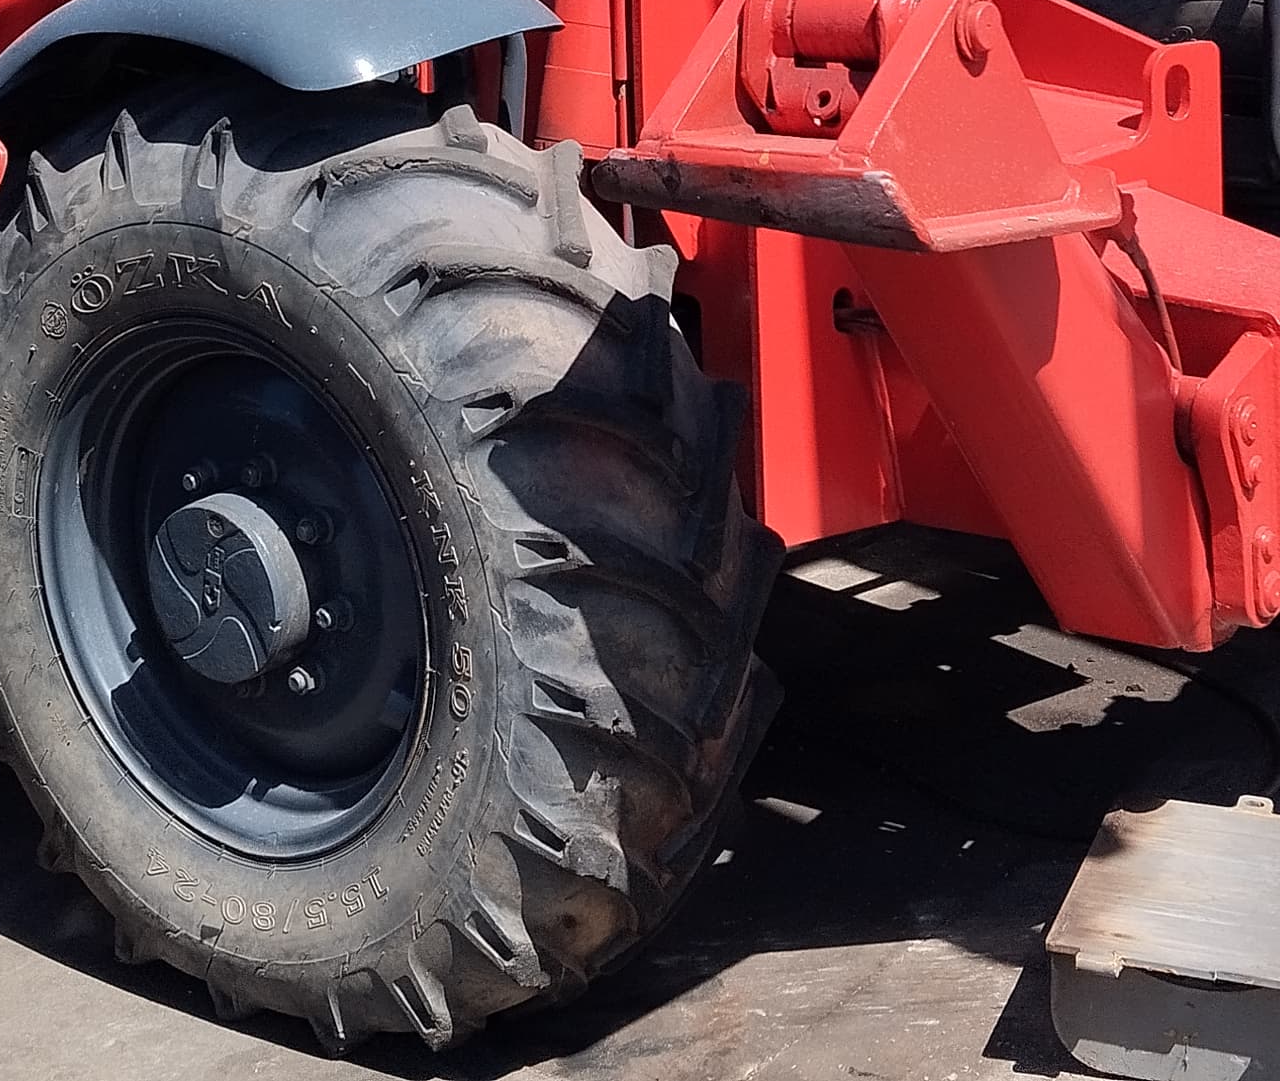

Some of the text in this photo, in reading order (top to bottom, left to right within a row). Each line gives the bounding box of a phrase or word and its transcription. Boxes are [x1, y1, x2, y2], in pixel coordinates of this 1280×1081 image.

[70, 249, 294, 330] ÖZKA
[410, 469, 475, 722] KNK 50
[144, 846, 391, 935] 15.5/80-24
